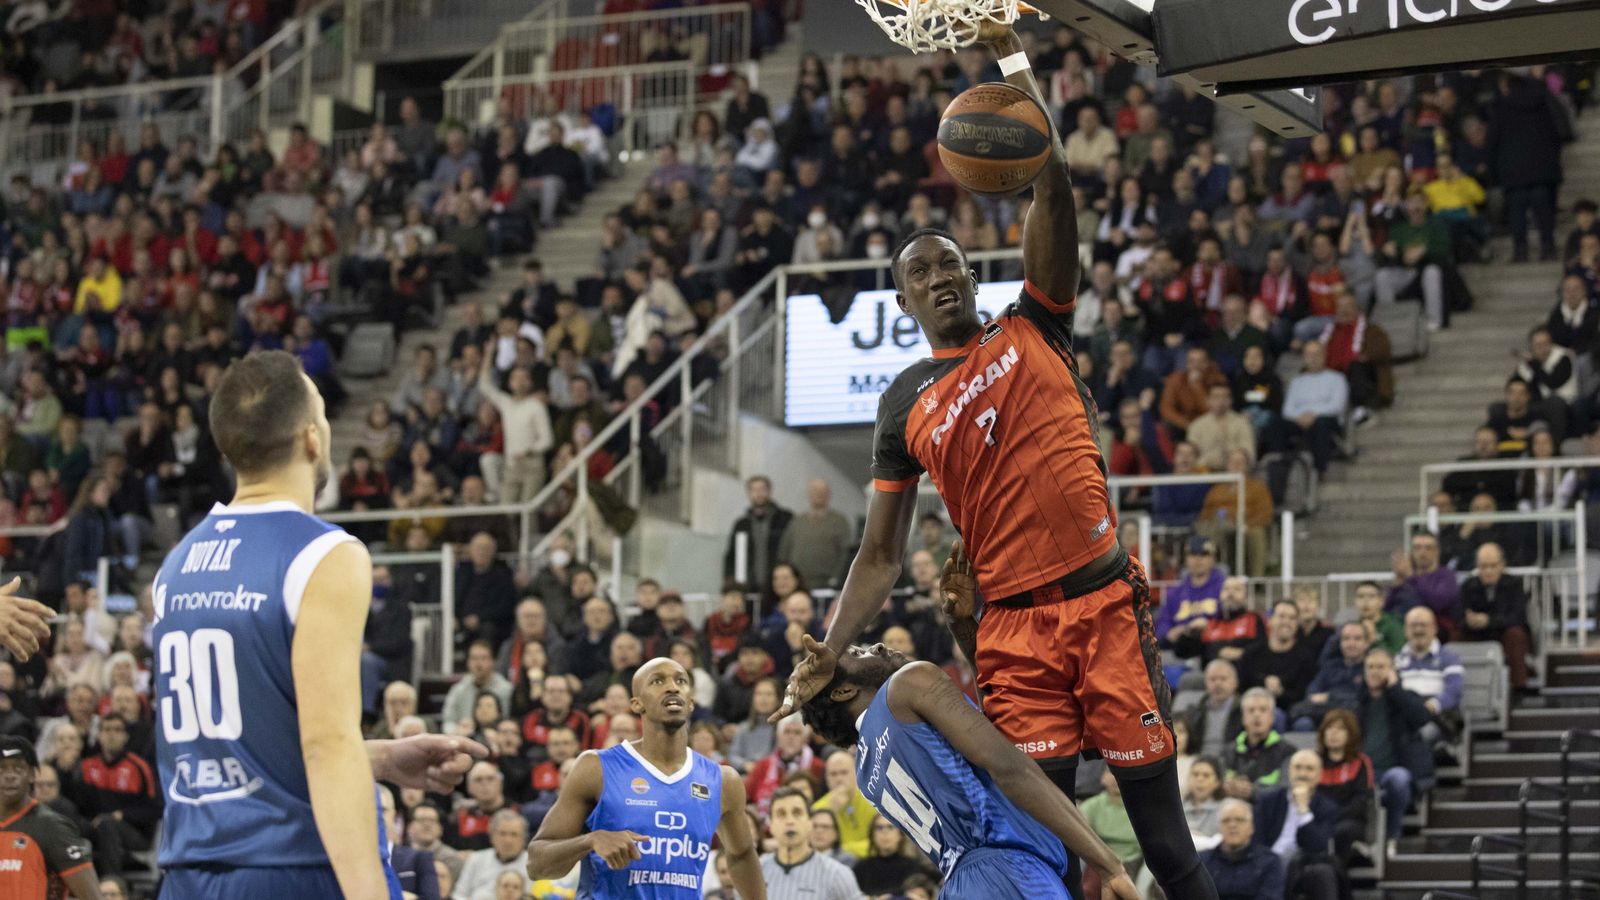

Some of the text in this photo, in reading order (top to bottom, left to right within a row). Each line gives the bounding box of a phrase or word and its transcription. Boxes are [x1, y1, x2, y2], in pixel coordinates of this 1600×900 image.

[950, 120, 1026, 148] SPALDING
[974, 406, 997, 447] 7
[181, 538, 242, 574] NOVAK
[159, 628, 243, 743] 30
[1144, 715, 1160, 726] acb
[1109, 749, 1145, 761] BERNER
[881, 756, 942, 854] 44
[633, 834, 710, 865] arplus
[628, 869, 700, 890] FUENLABRAD
